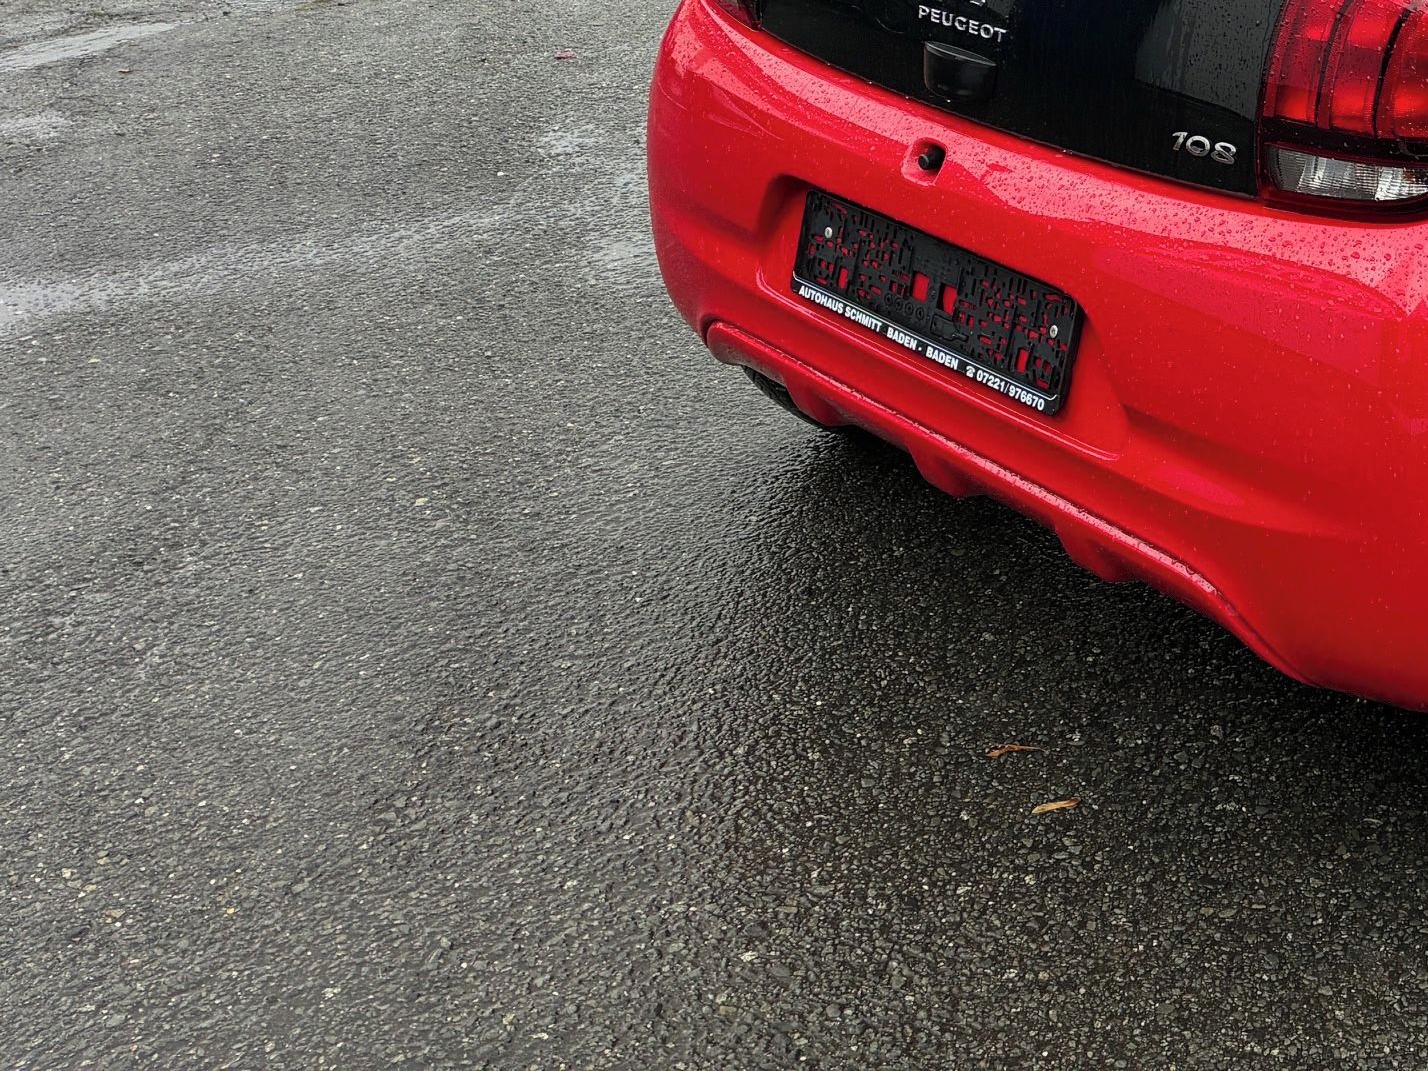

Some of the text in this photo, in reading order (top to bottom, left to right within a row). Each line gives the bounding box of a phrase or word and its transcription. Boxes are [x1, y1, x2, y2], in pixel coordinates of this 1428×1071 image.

[918, 4, 1008, 43] PEUGEOT
[1171, 131, 1237, 165] 108
[798, 285, 844, 314] AUTOHAUS
[844, 306, 883, 333] SCHMITT
[886, 326, 918, 351] BADEN
[925, 345, 959, 371] BADEN
